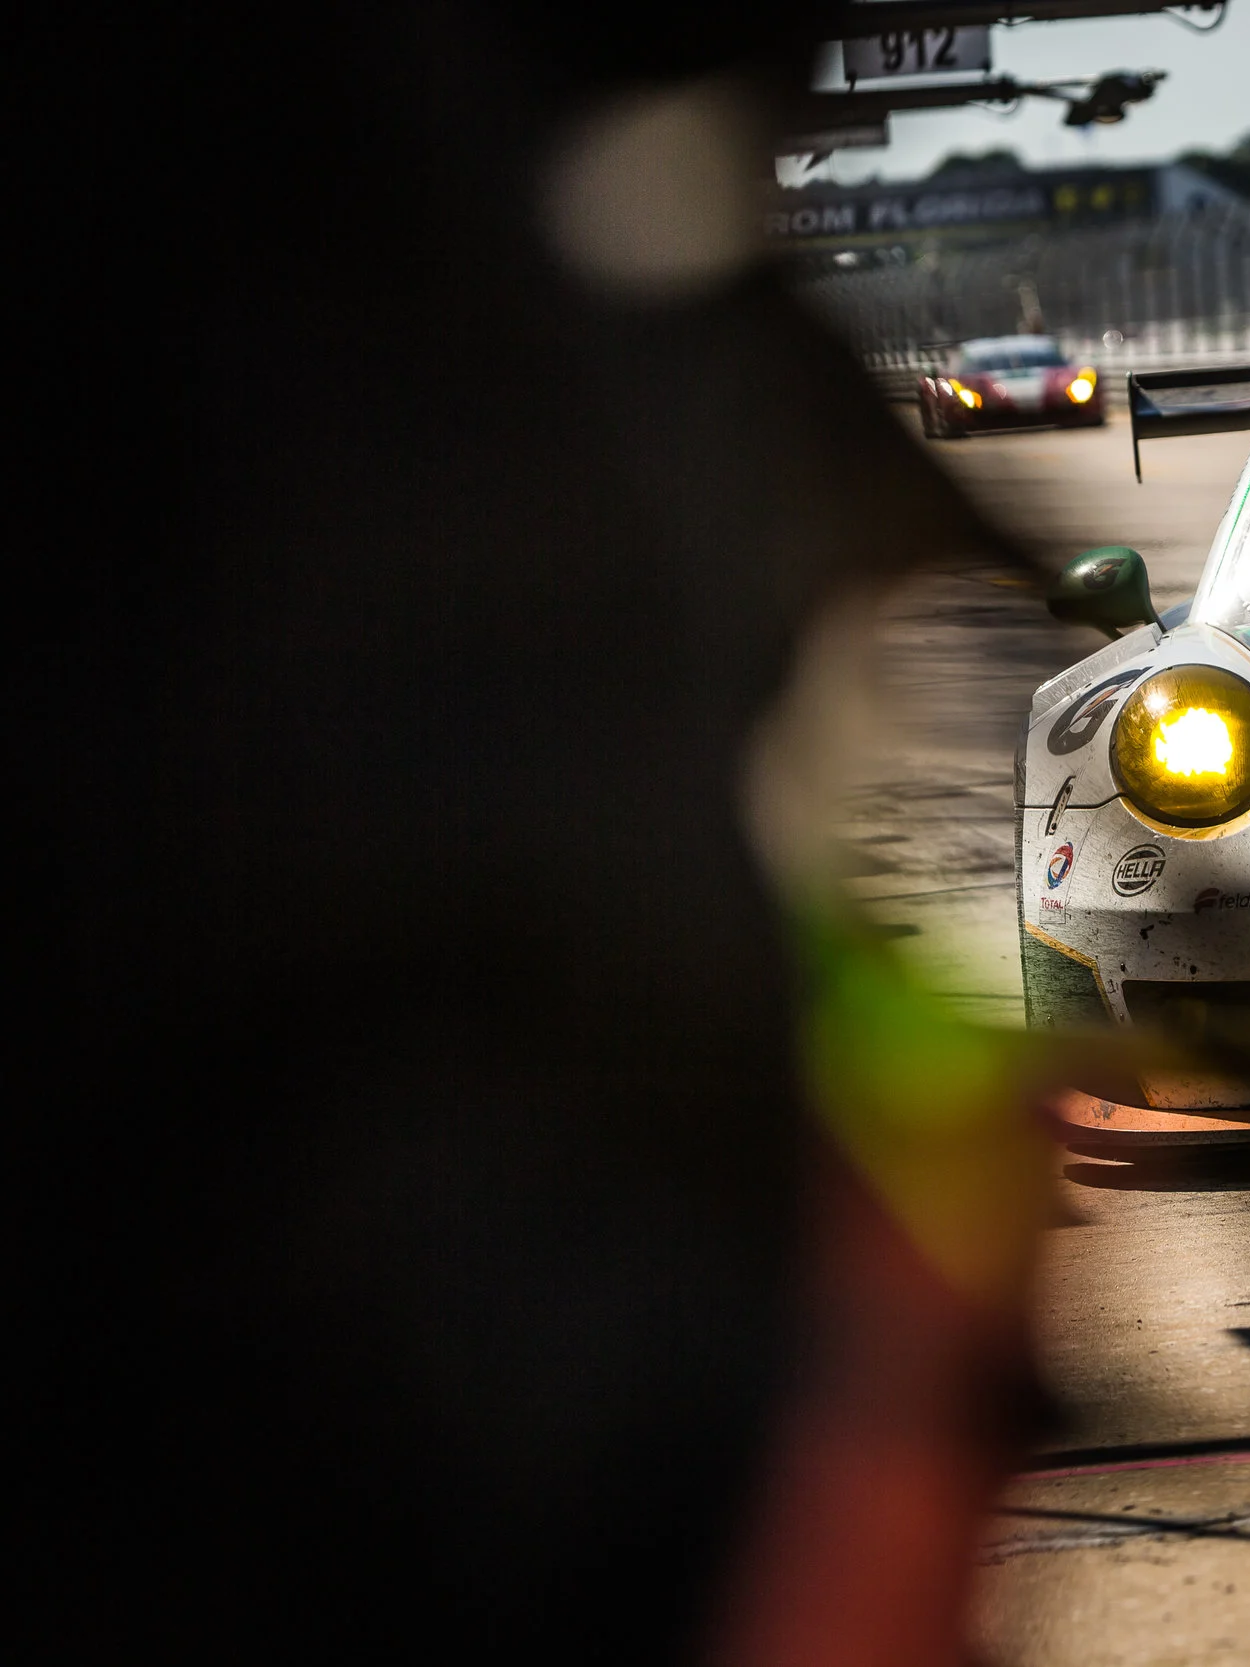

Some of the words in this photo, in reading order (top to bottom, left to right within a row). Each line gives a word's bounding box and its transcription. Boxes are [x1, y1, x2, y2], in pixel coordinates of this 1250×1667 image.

[881, 26, 957, 70] 912
[765, 204, 856, 235] ROM
[1115, 855, 1166, 879] HELLA
[1040, 896, 1065, 910] TOTAL
